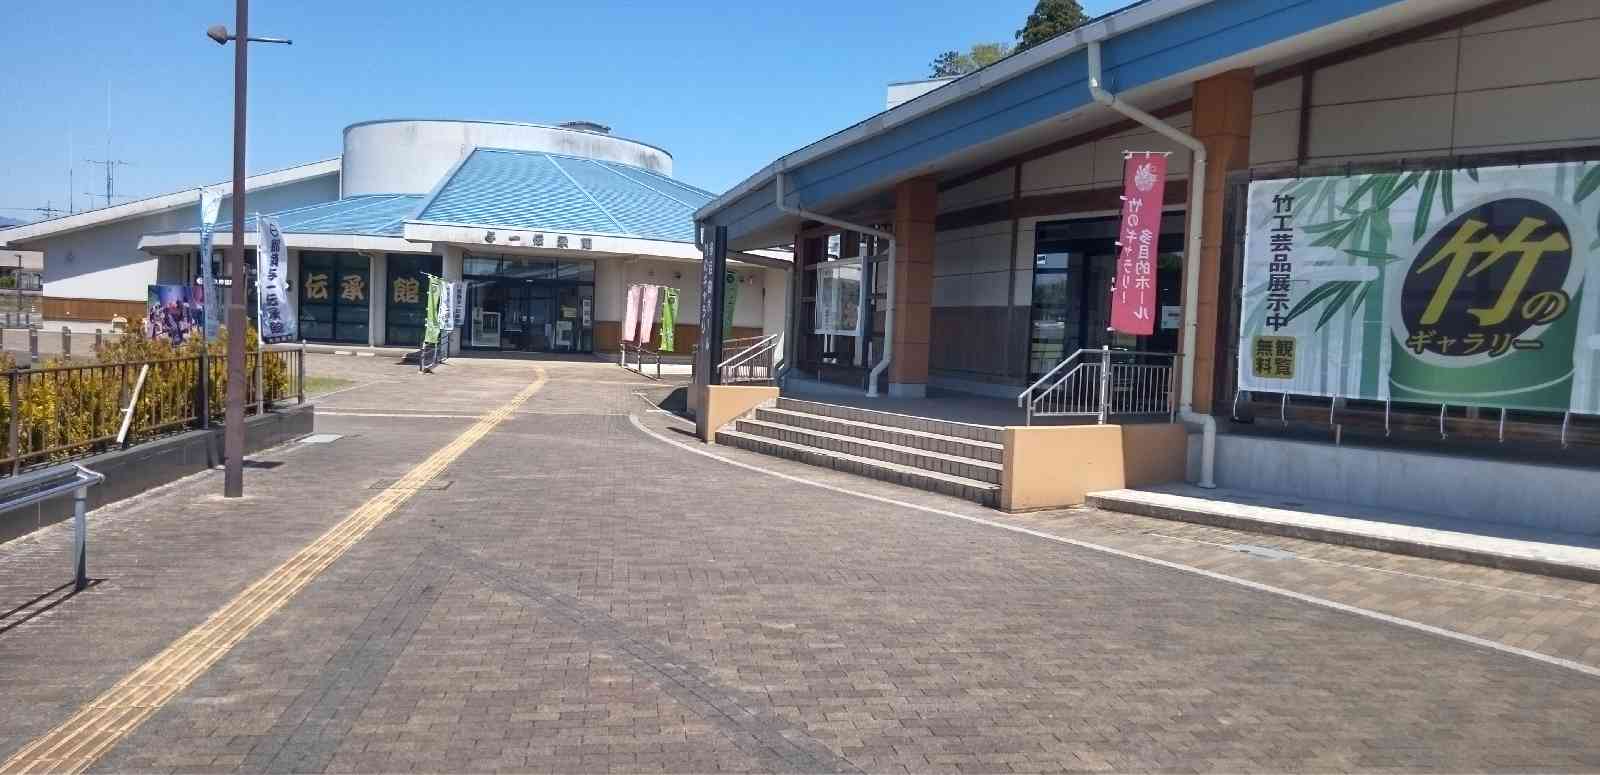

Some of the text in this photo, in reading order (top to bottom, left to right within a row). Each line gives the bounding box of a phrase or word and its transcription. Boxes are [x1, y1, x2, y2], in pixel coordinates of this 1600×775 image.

[1134, 229, 1153, 319] 多目的ホール
[1265, 194, 1295, 332] 竹工芸品展示中
[1416, 216, 1570, 326] 竹の
[1255, 339, 1274, 377] 無料
[1274, 339, 1294, 377] 観覧
[1408, 332, 1543, 356] ギャラリー
